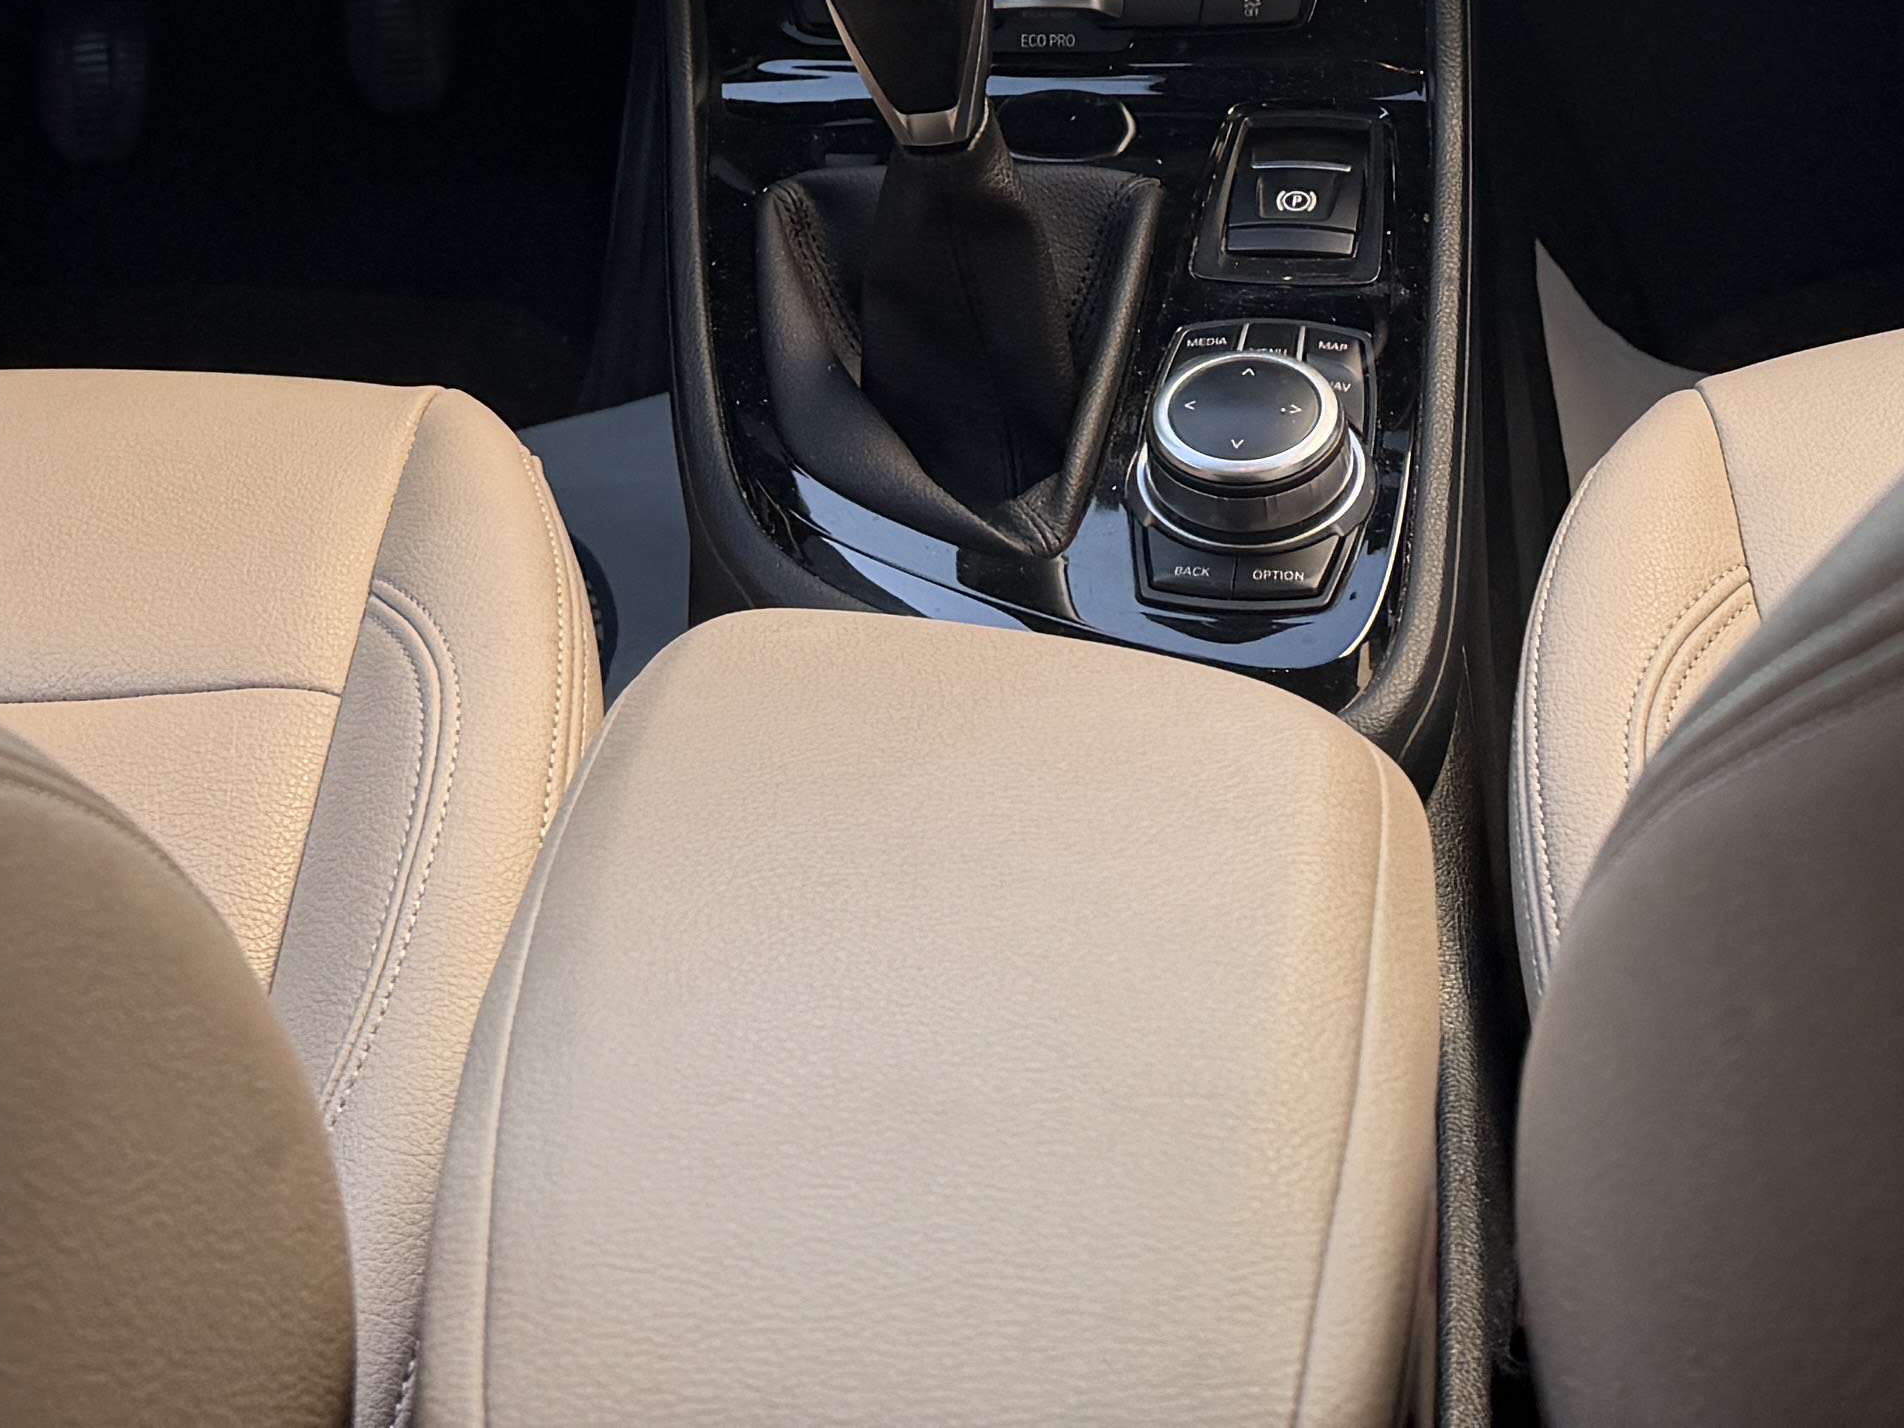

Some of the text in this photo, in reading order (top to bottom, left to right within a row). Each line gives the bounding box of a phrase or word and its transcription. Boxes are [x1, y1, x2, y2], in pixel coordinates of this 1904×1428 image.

[1020, 33, 1076, 48] ECO PRO
[1186, 336, 1228, 348] MEDIA
[1317, 340, 1349, 352] MAP
[1174, 564, 1212, 577] BACK
[1251, 568, 1305, 582] OPTION
